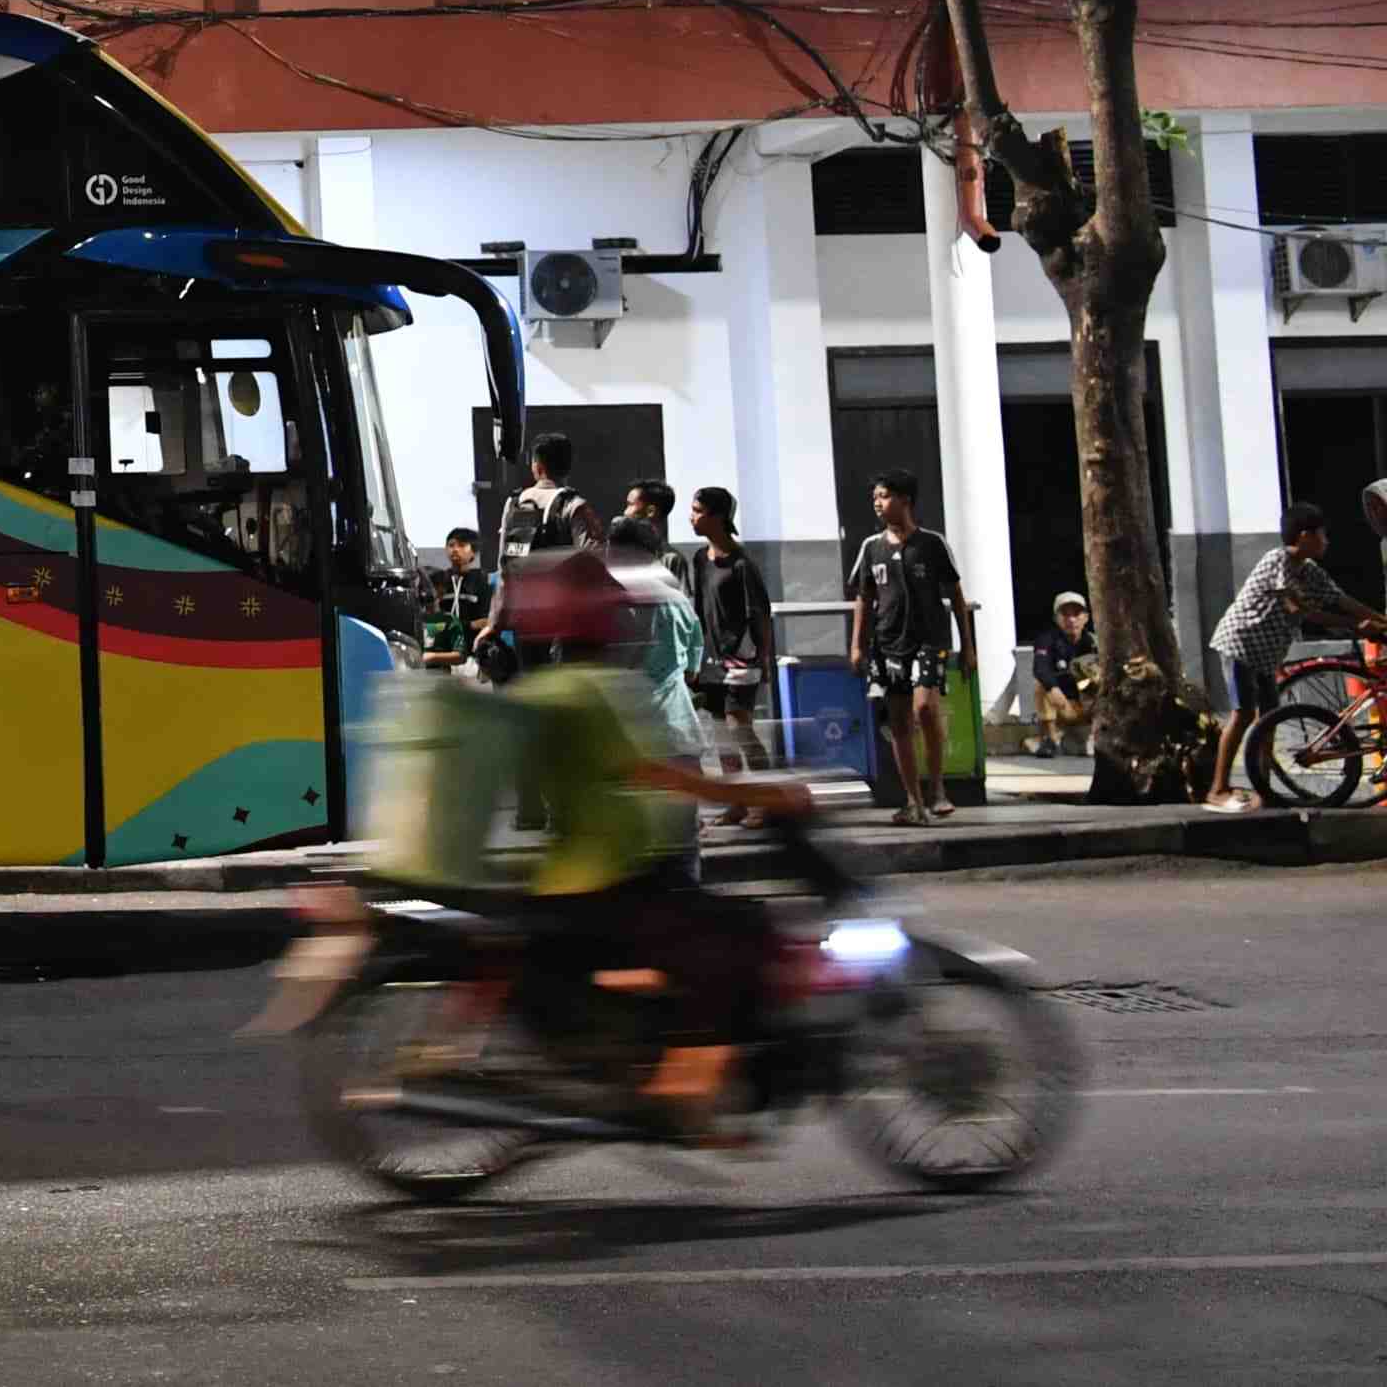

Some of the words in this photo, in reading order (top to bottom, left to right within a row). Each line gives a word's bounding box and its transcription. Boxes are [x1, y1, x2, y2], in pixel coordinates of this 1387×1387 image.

[121, 175, 146, 184] Good
[122, 186, 153, 196] Design
[122, 196, 166, 206] Indonesia
